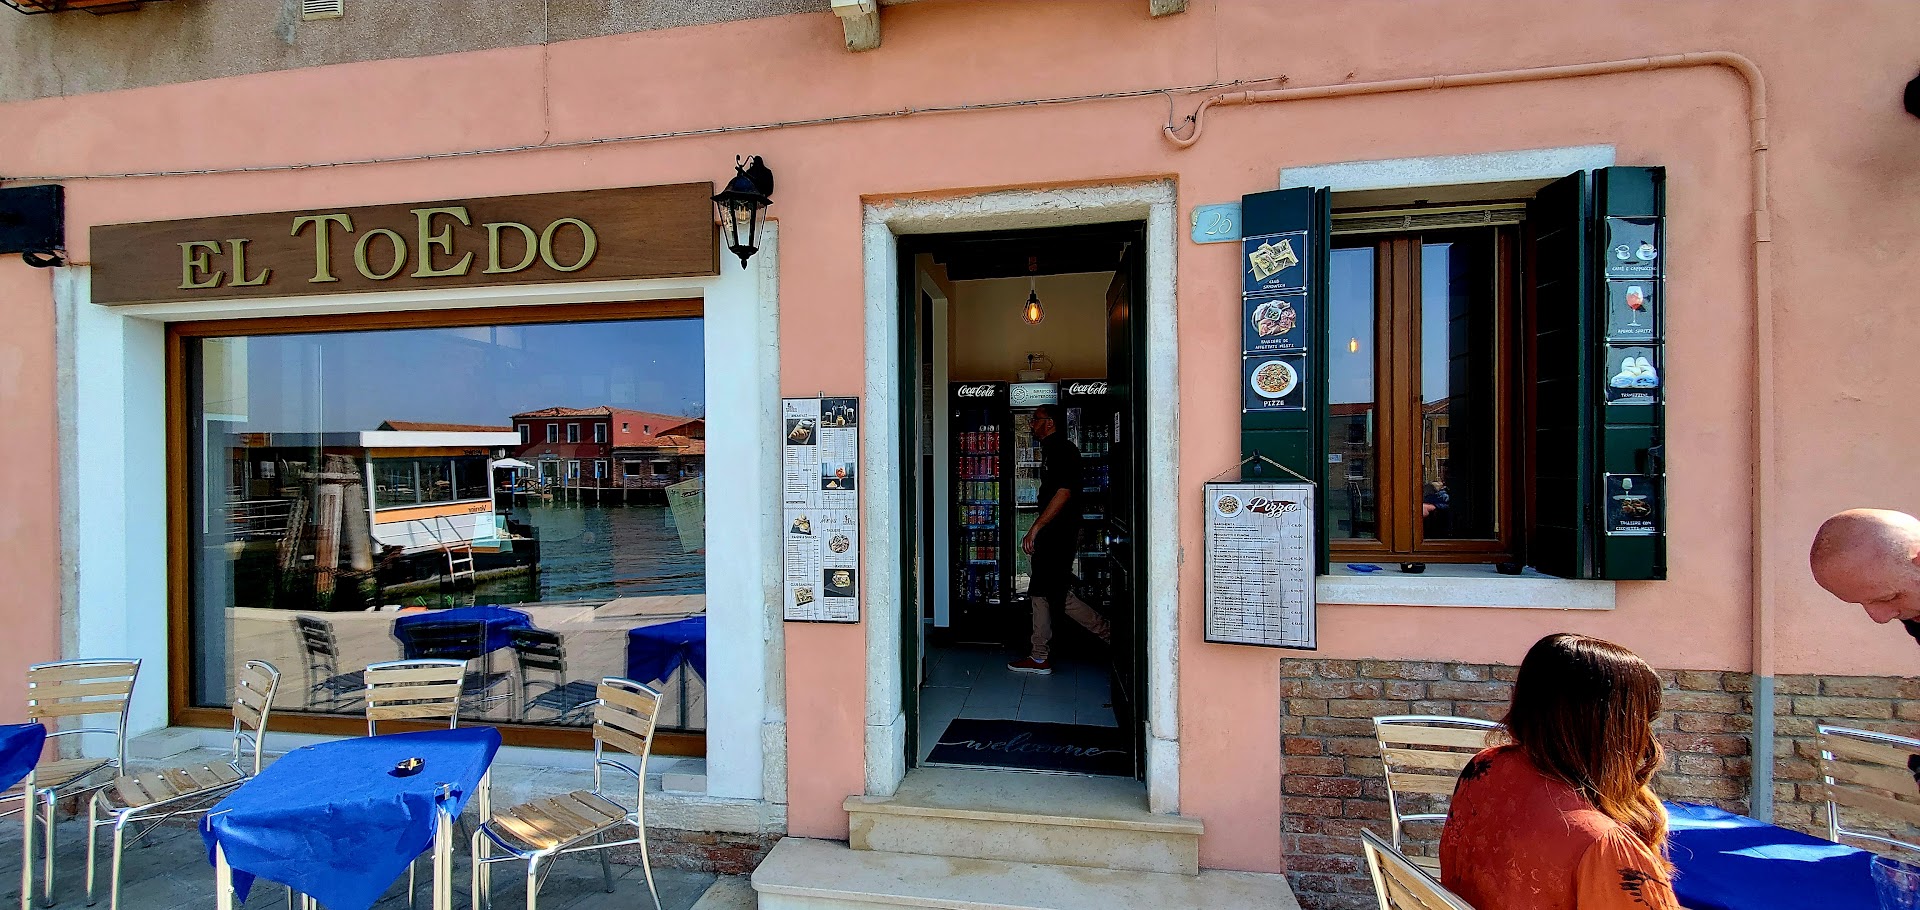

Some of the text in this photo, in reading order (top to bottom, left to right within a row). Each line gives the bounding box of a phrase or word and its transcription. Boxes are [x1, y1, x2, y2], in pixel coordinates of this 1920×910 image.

[178, 238, 272, 290] EL
[1263, 399, 1285, 407] PIZZE
[1248, 495, 1298, 519] Pizza
[938, 731, 1128, 758] welcome
